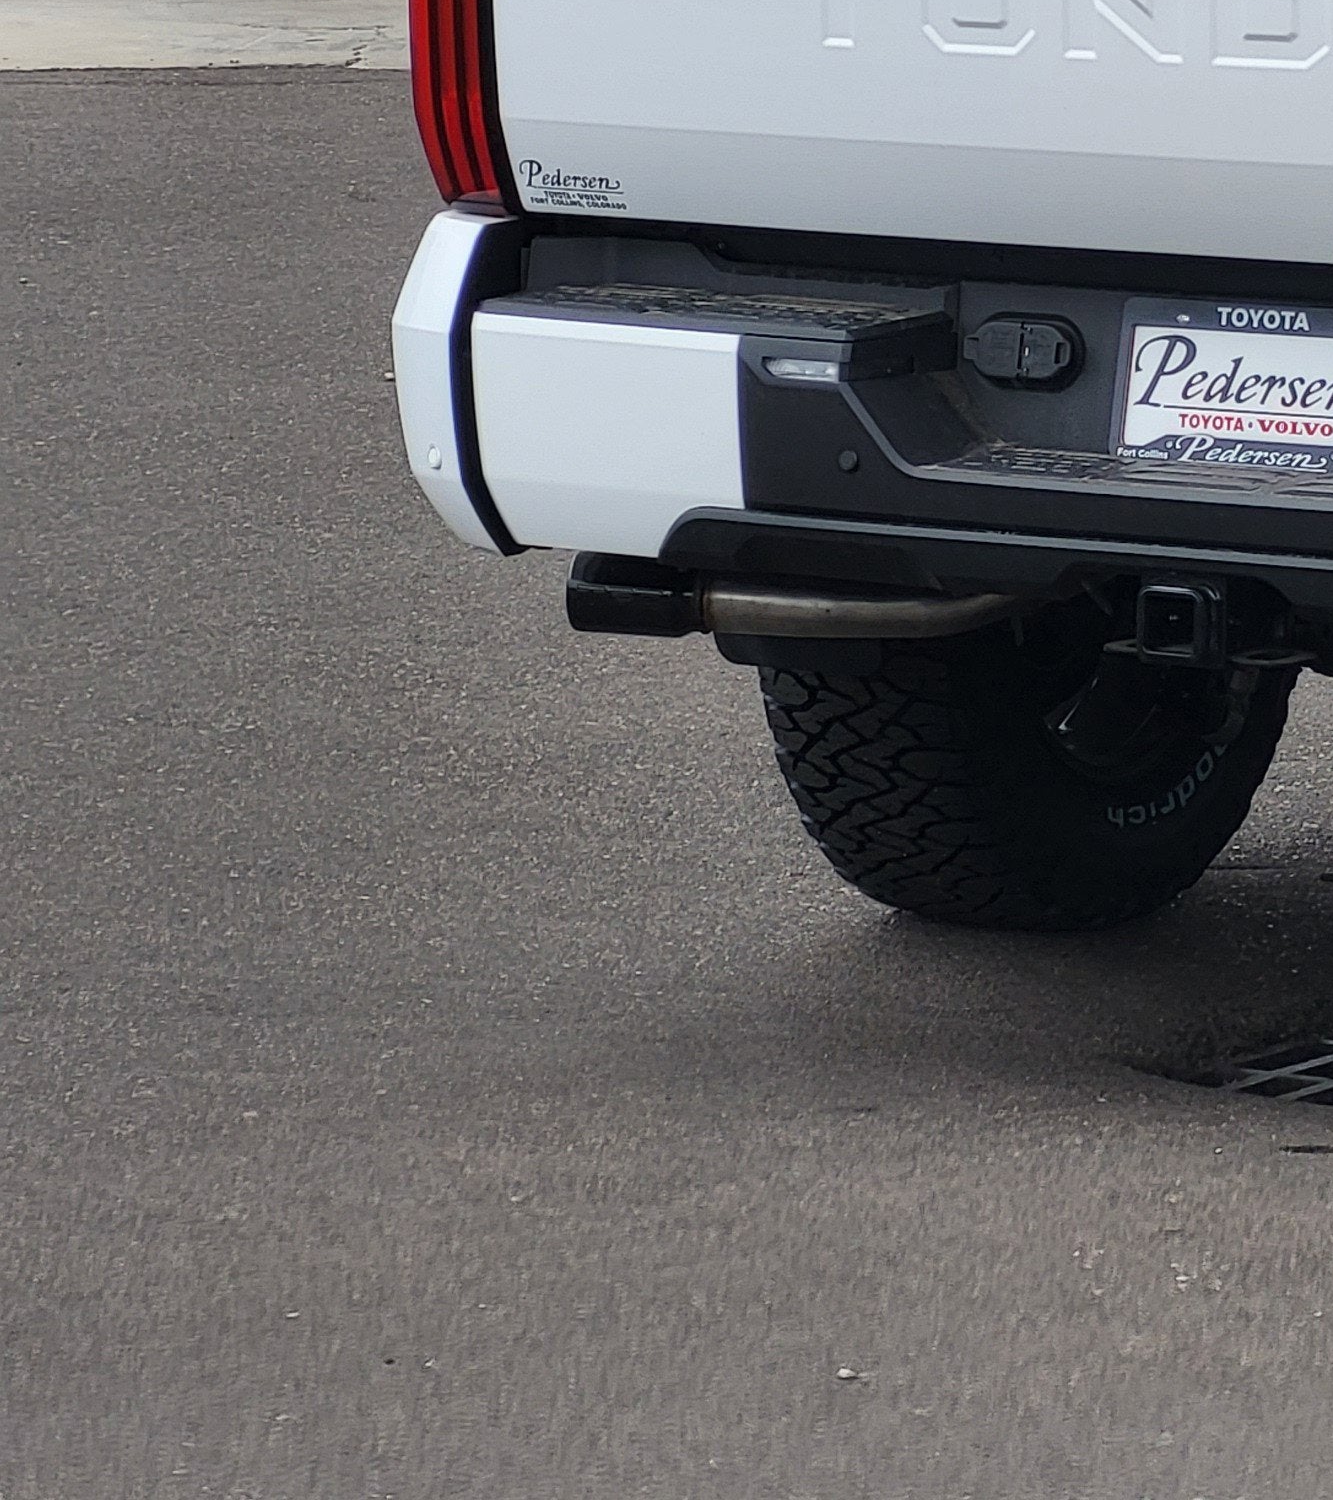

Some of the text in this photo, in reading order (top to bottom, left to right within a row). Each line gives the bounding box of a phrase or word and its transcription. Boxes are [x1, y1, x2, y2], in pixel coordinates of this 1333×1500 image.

[518, 159, 621, 190] Pedersen
[543, 190, 609, 201] TOYOTA VOLVO
[587, 200, 627, 210] COLORADO
[1216, 306, 1311, 332] TOYOTA
[1178, 413, 1245, 432] TOYOTA
[1116, 446, 1169, 460] Fort Collins
[1175, 434, 1328, 469] Pedersen
